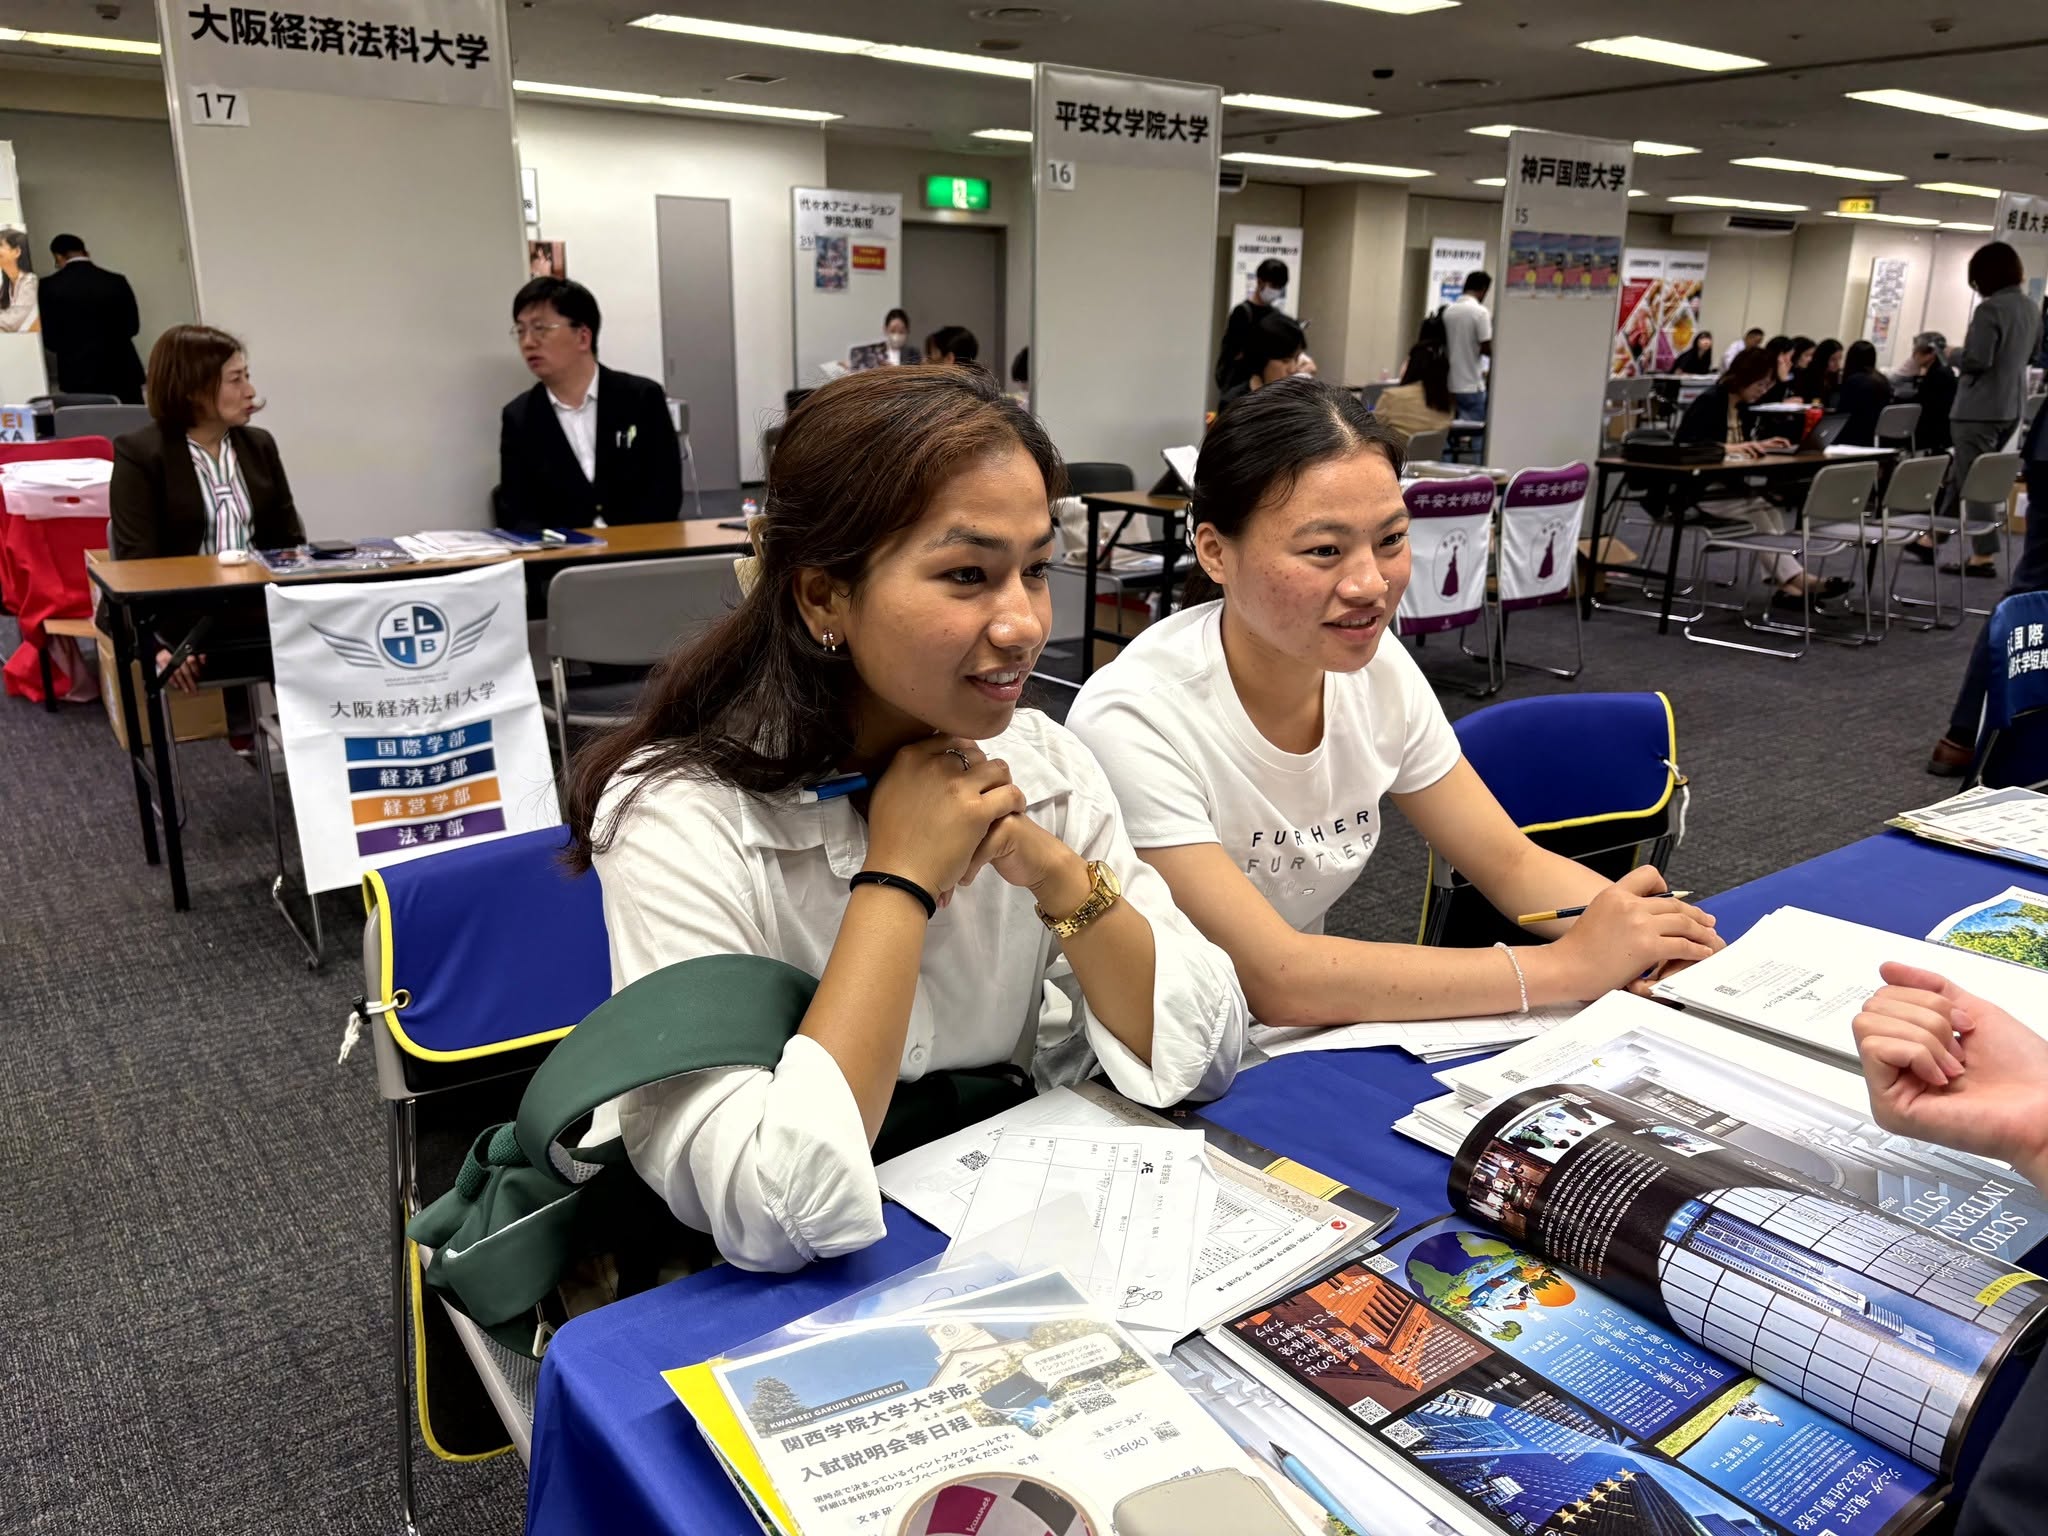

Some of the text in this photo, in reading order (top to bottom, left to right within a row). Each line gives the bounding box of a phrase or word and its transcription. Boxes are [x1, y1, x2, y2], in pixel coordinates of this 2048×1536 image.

[188, 6, 490, 70] 大阪経済法科大学
[196, 93, 237, 120] 17
[1055, 100, 1209, 143] 平安女学院大学
[1049, 163, 1072, 185] 16
[1520, 153, 1626, 192] 神戸国際大学
[1515, 208, 1529, 224] 15
[329, 680, 496, 720] 大阪経済法科大学
[377, 730, 466, 757] 国際学部
[380, 759, 468, 787] 経済学部
[383, 786, 471, 817] 経営学部
[398, 818, 464, 845] 法学部
[1896, 1191, 1950, 1224] STU
[1970, 1211, 2028, 1251] SCHO
[1255, 1319, 1285, 1337] チカラ
[1278, 1328, 1327, 1356] 自治体発
[1600, 1308, 1724, 1380] 見つける戦略とは
[1304, 1333, 1382, 1377] 国を変えるのは
[769, 1383, 905, 1429] KWANSEI GAKUIN UNIVERSITY
[780, 1383, 973, 1453] 関西学院大学大学院
[800, 1415, 974, 1482] 入試説明会等日程
[1793, 1455, 1885, 1530] 「人を支える仕事」に光を
[1835, 1467, 1902, 1524] ジェンダー視点で
[856, 1504, 897, 1525] 文学研
